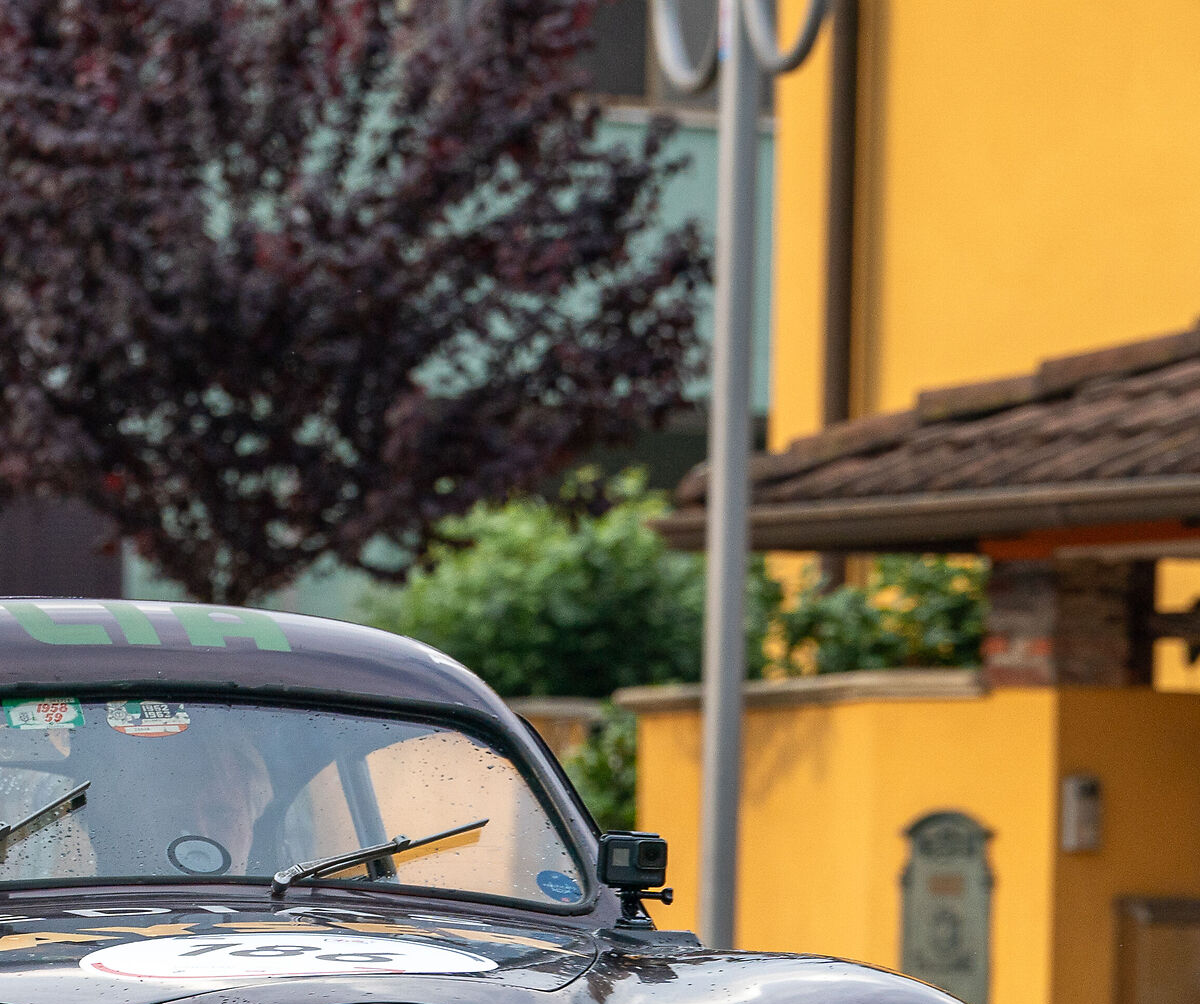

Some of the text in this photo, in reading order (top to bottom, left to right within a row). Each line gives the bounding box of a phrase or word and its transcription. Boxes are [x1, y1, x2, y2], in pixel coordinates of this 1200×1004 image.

[36, 702, 68, 713] 1958
[45, 712, 63, 723] 59
[178, 943, 405, 962] 186
